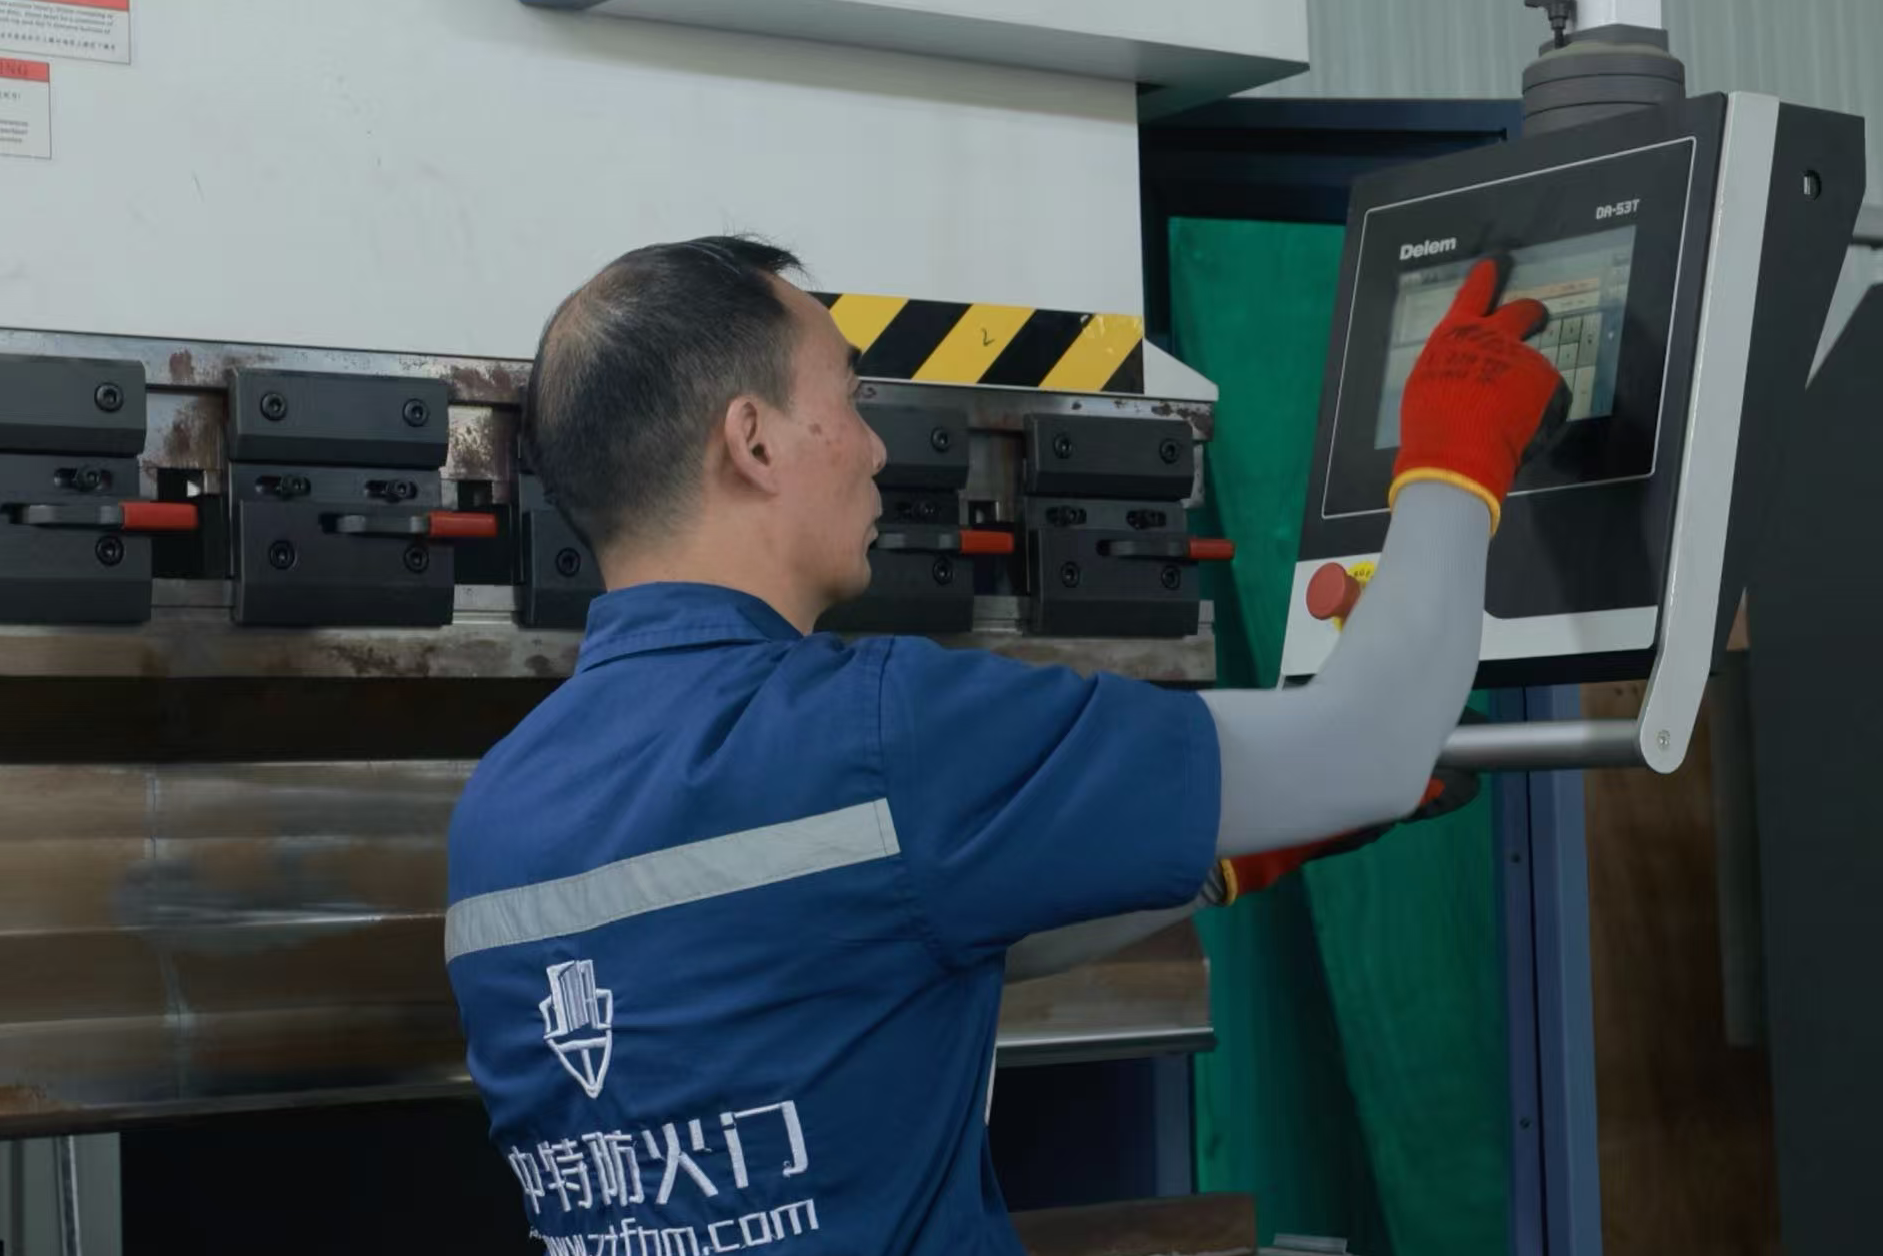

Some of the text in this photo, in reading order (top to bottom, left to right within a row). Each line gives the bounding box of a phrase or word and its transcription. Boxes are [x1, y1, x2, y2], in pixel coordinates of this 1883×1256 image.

[1595, 199, 1640, 219] DA-53T
[1399, 237, 1457, 260] Delem
[508, 1100, 809, 1215] 中特防火门
